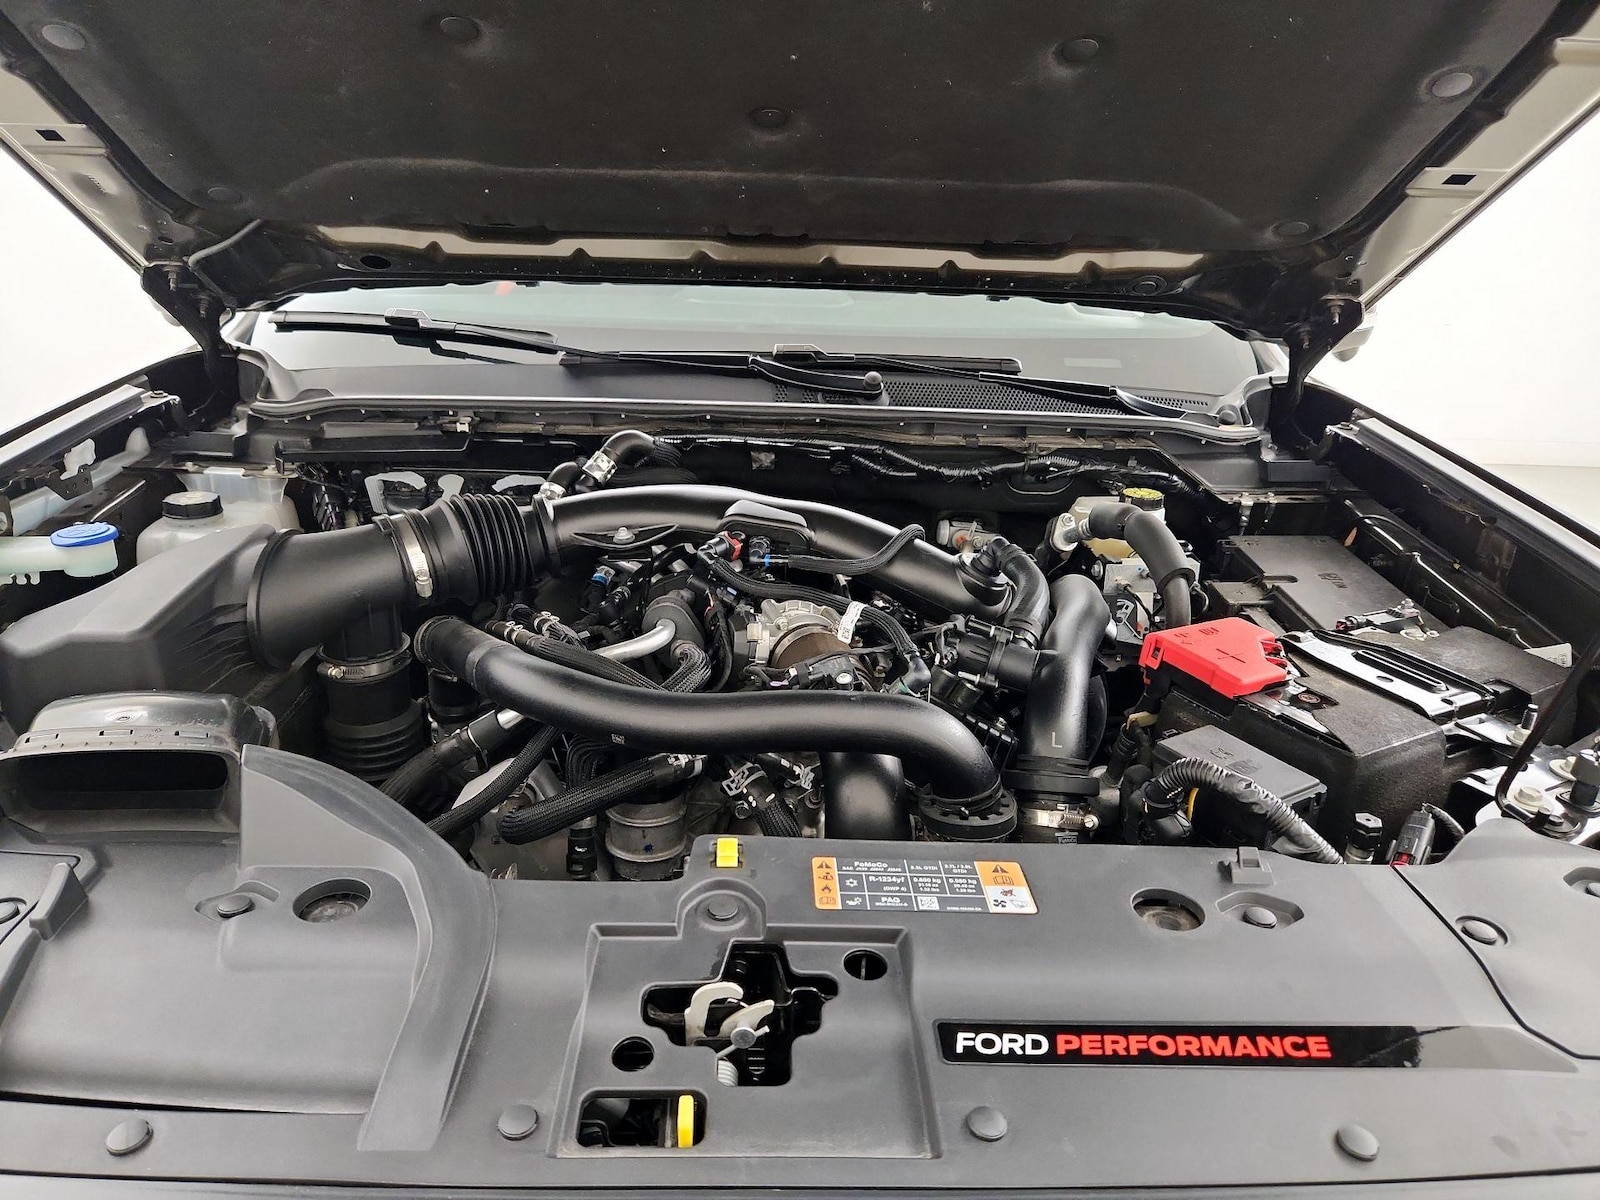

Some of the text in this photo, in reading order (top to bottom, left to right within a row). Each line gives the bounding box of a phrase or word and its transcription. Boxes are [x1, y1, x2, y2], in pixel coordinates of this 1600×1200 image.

[1051, 731, 1063, 748] L
[956, 1031, 1332, 1058] FORD PERFORMANCE
